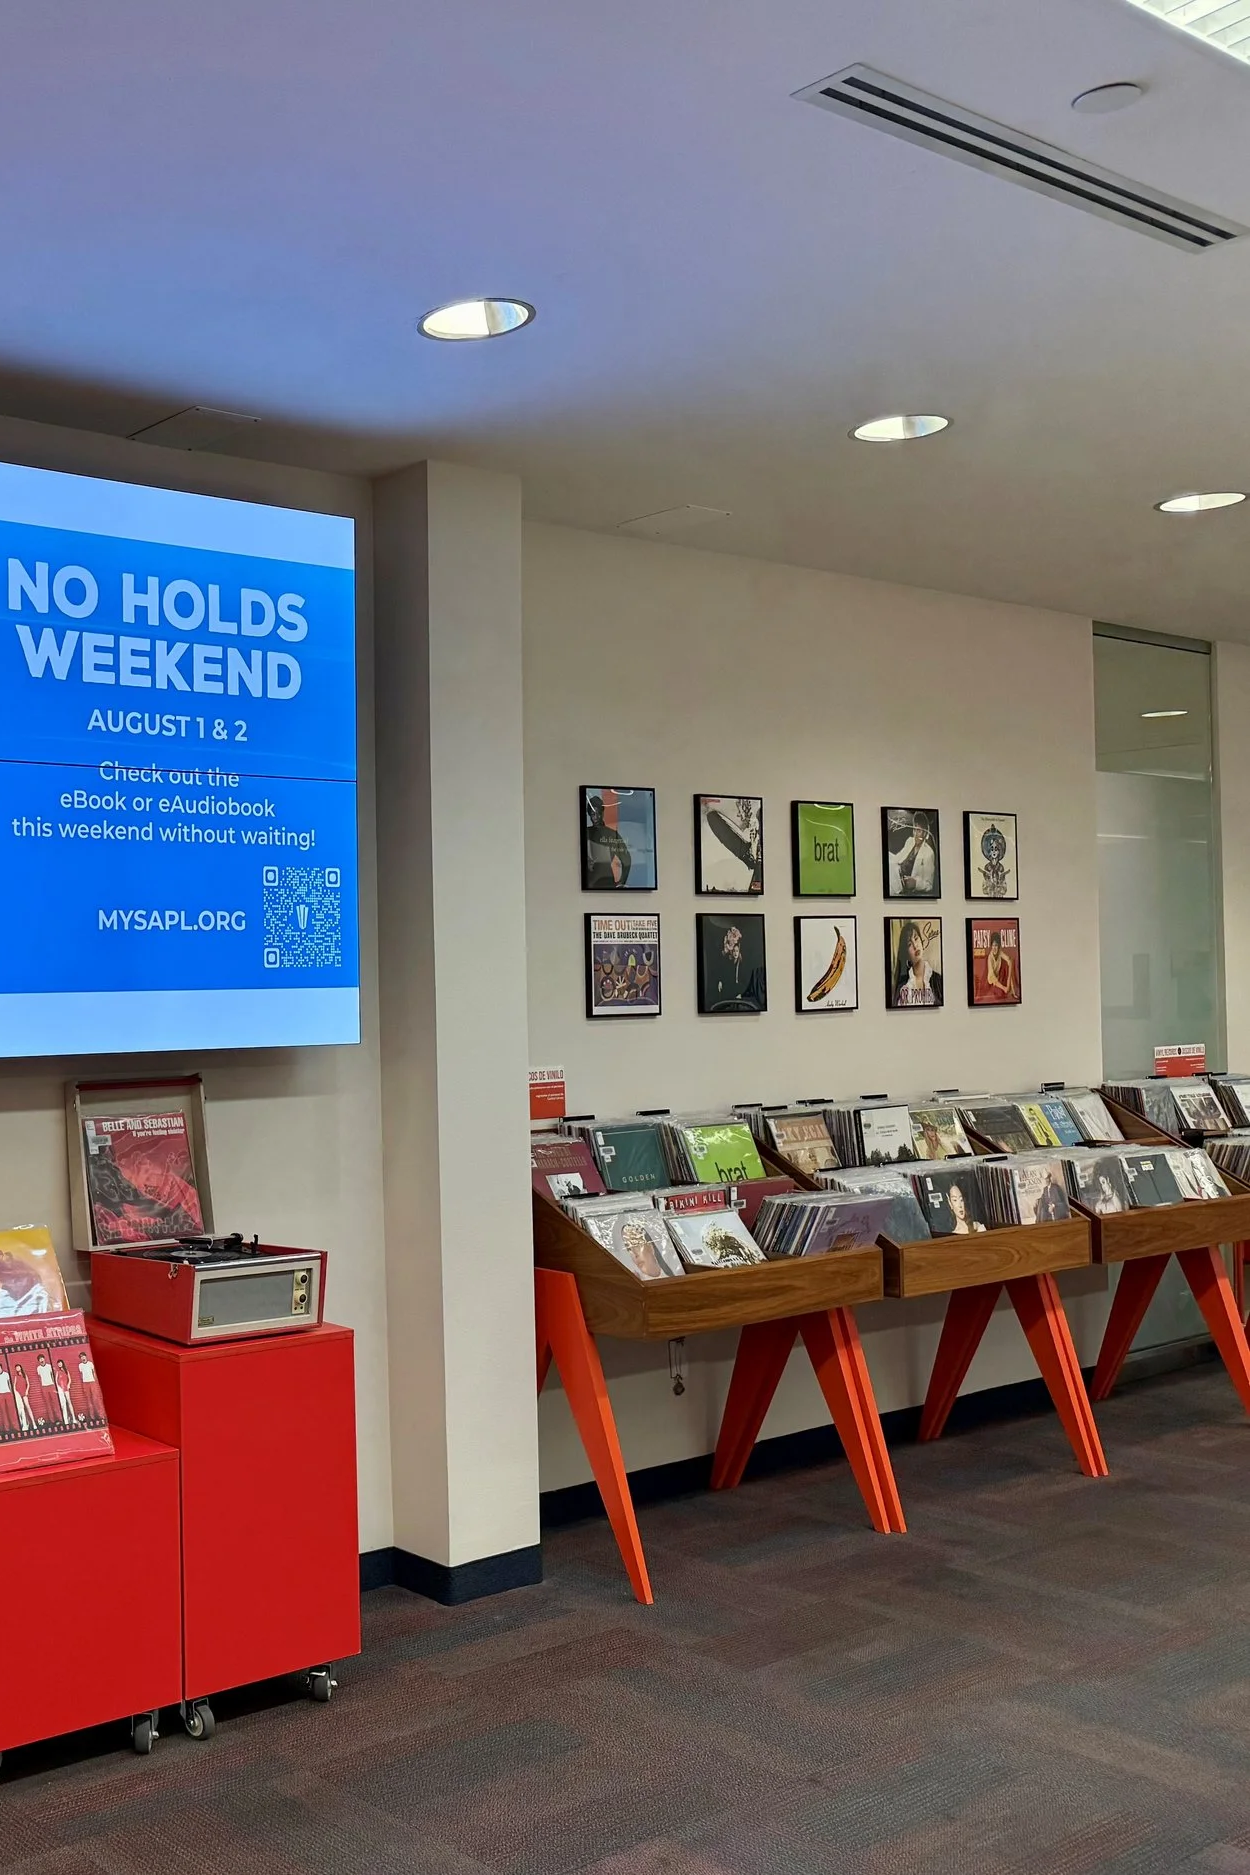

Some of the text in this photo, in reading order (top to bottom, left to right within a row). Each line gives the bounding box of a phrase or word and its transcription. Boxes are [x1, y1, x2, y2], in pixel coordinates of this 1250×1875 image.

[8, 557, 308, 643] NO HOLDS
[15, 624, 302, 700] WEEKEND
[87, 709, 248, 742] AUGUST 1 & 2
[99, 760, 239, 788] Check out the
[60, 790, 276, 818] eBook or eAudiobook
[12, 816, 316, 851] this weekend without waiting!
[814, 836, 840, 863] brat
[98, 910, 246, 931] MYSAPL.ORG
[593, 920, 612, 930] TIME
[615, 920, 630, 930] OUT
[974, 929, 1016, 948] PATSY CLINE
[539, 1071, 546, 1080] DE
[547, 1070, 563, 1079] VINILO
[102, 1121, 125, 1132] BELLE
[127, 1120, 142, 1130] AND
[144, 1117, 184, 1129] SEBASTIAN
[622, 1173, 656, 1183] GOLDEN
[714, 1161, 749, 1182] brat
[669, 1193, 721, 1209] BIKINI KILL
